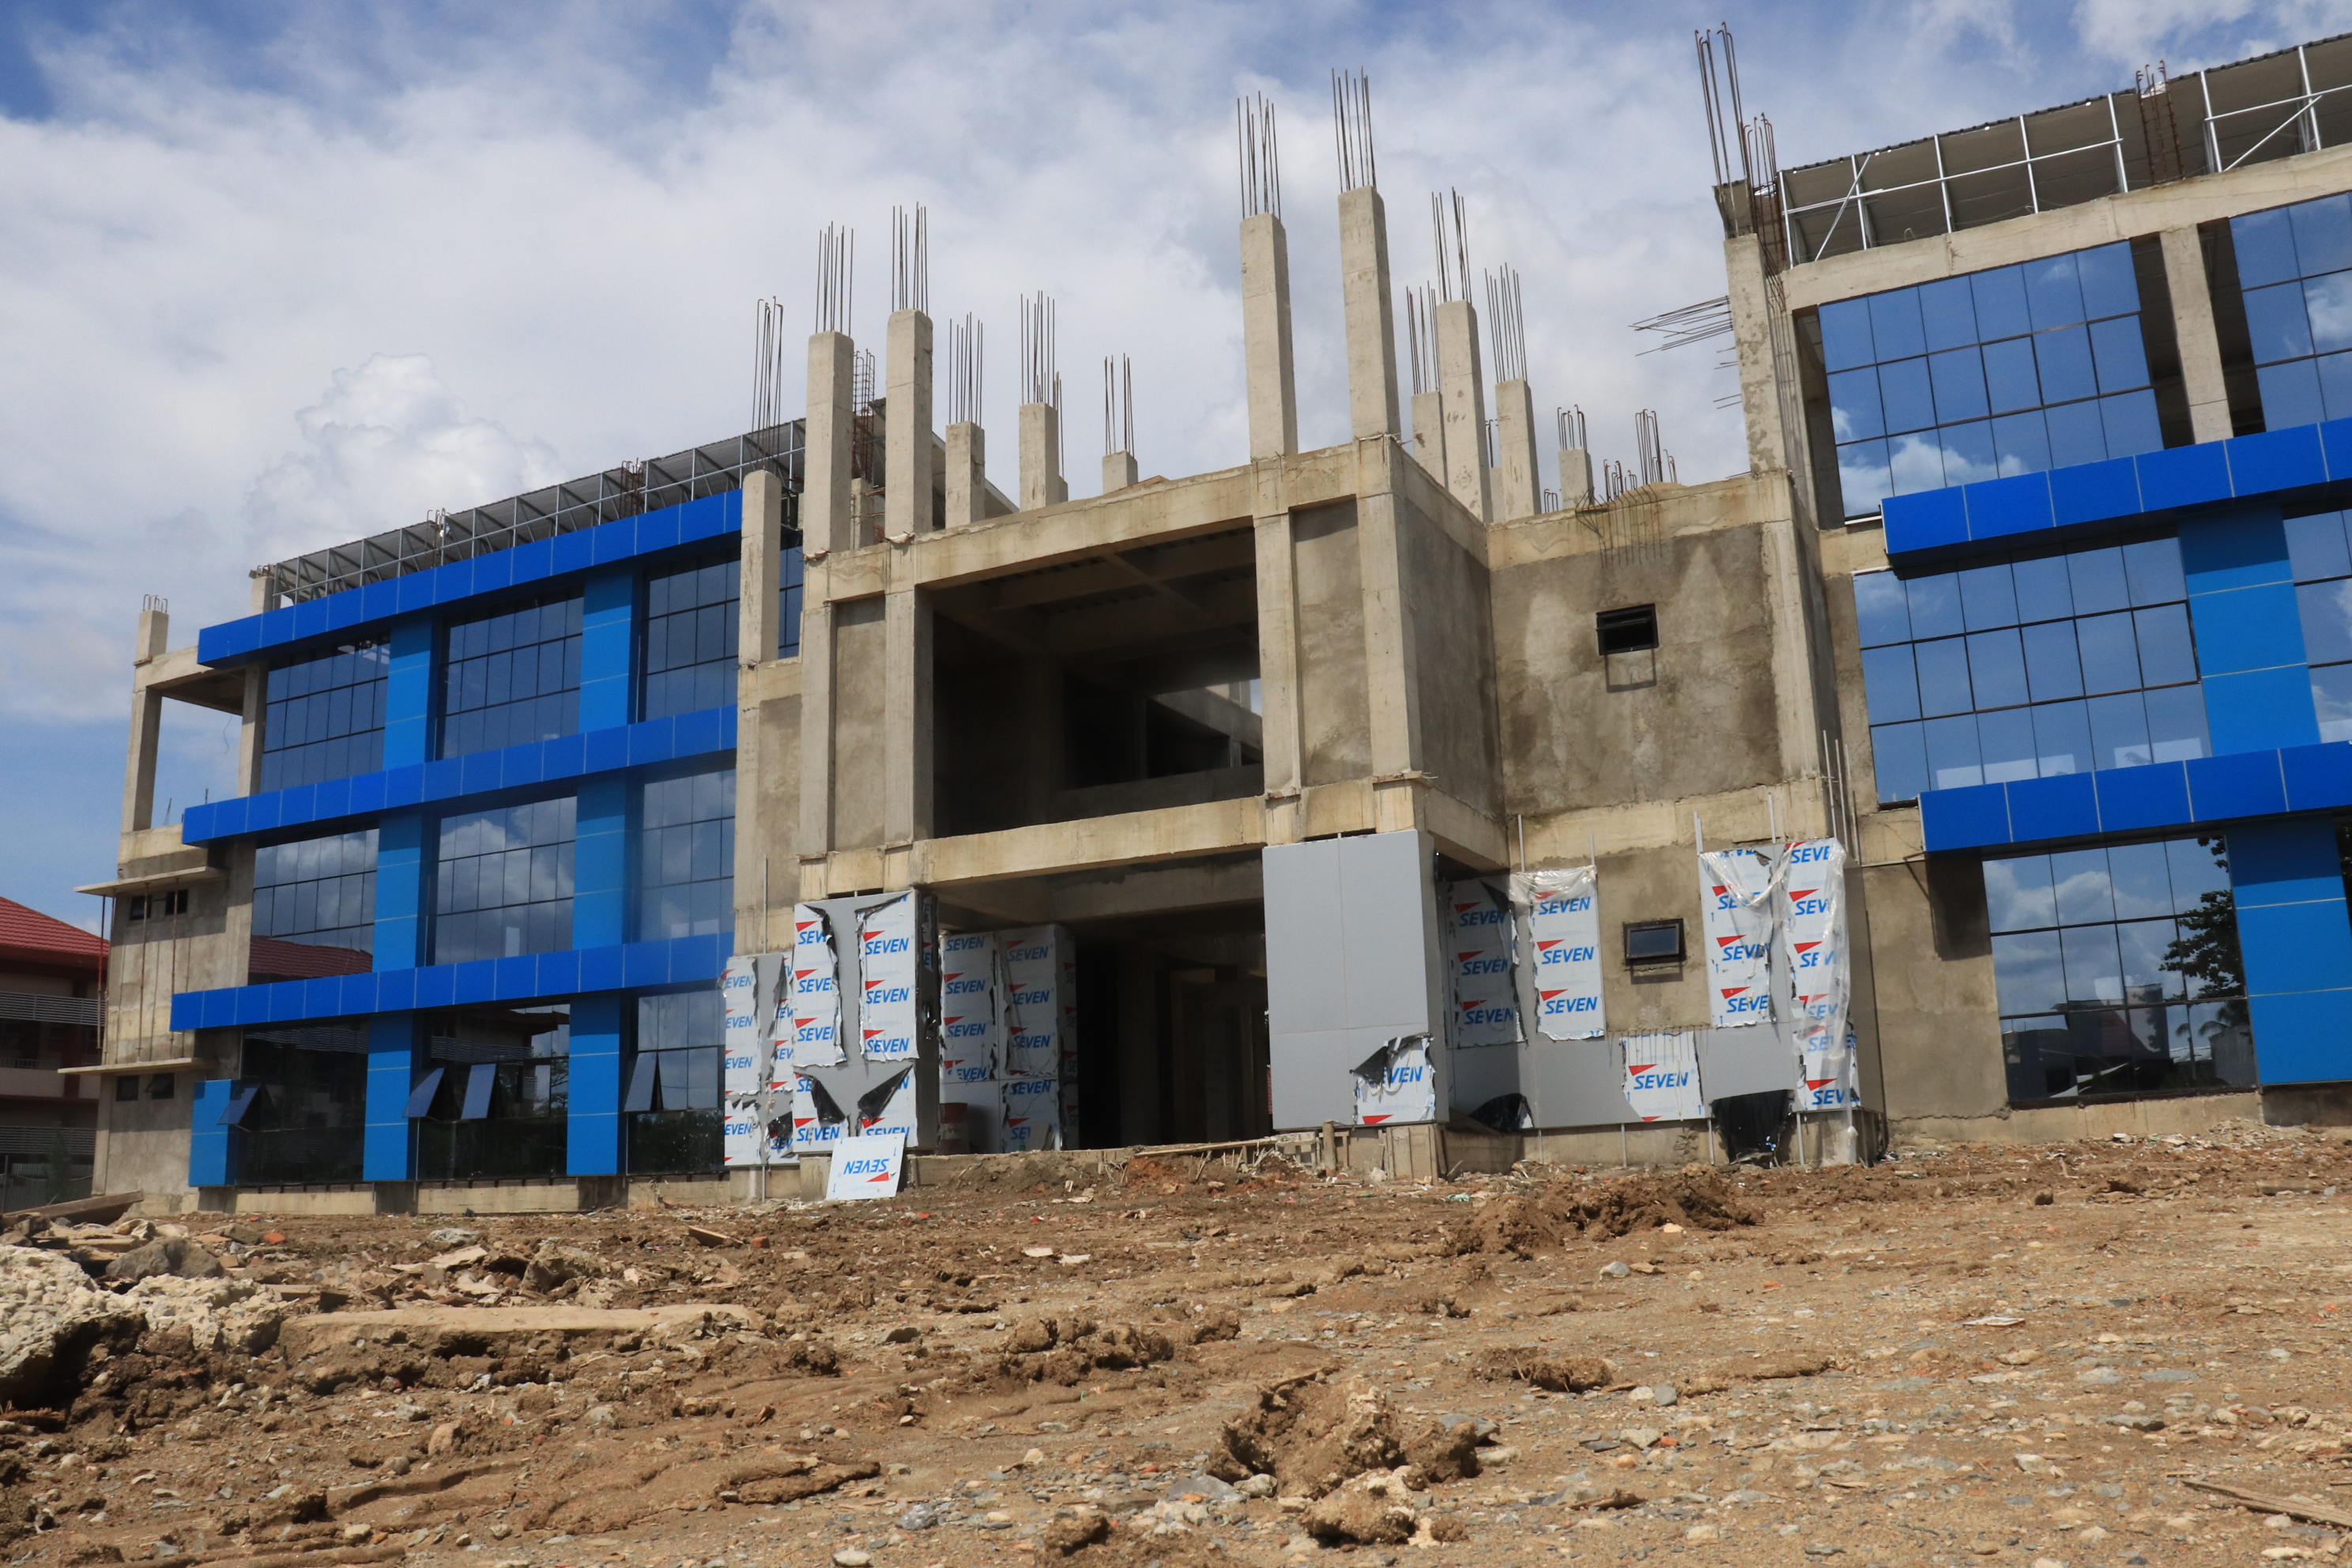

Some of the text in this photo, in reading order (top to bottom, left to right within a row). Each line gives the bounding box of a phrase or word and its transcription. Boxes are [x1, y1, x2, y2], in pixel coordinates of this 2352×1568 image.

[1539, 897, 1592, 915] SEVEN
[1459, 910, 1505, 927] SEVEN
[798, 930, 827, 944] SEV
[946, 937, 985, 952] SEVEN
[865, 938, 909, 956] SEVEN
[1007, 946, 1049, 962] SEVEN
[1540, 946, 1594, 965] SEVEN
[1461, 958, 1508, 976] SEVEN
[797, 977, 832, 993] SEVE
[945, 980, 986, 995] SEVEN
[866, 988, 909, 1004] SEVEN
[1012, 990, 1050, 1006] SEVEN
[1544, 997, 1597, 1015] SEVEN
[1464, 1008, 1513, 1025] SEVEN
[946, 1023, 986, 1038] SEVEN
[865, 1038, 910, 1053] SEVEN
[1012, 1035, 1050, 1049] SEVEN
[1634, 1072, 1689, 1090] SEVEN
[843, 1159, 889, 1174] SEVEN
